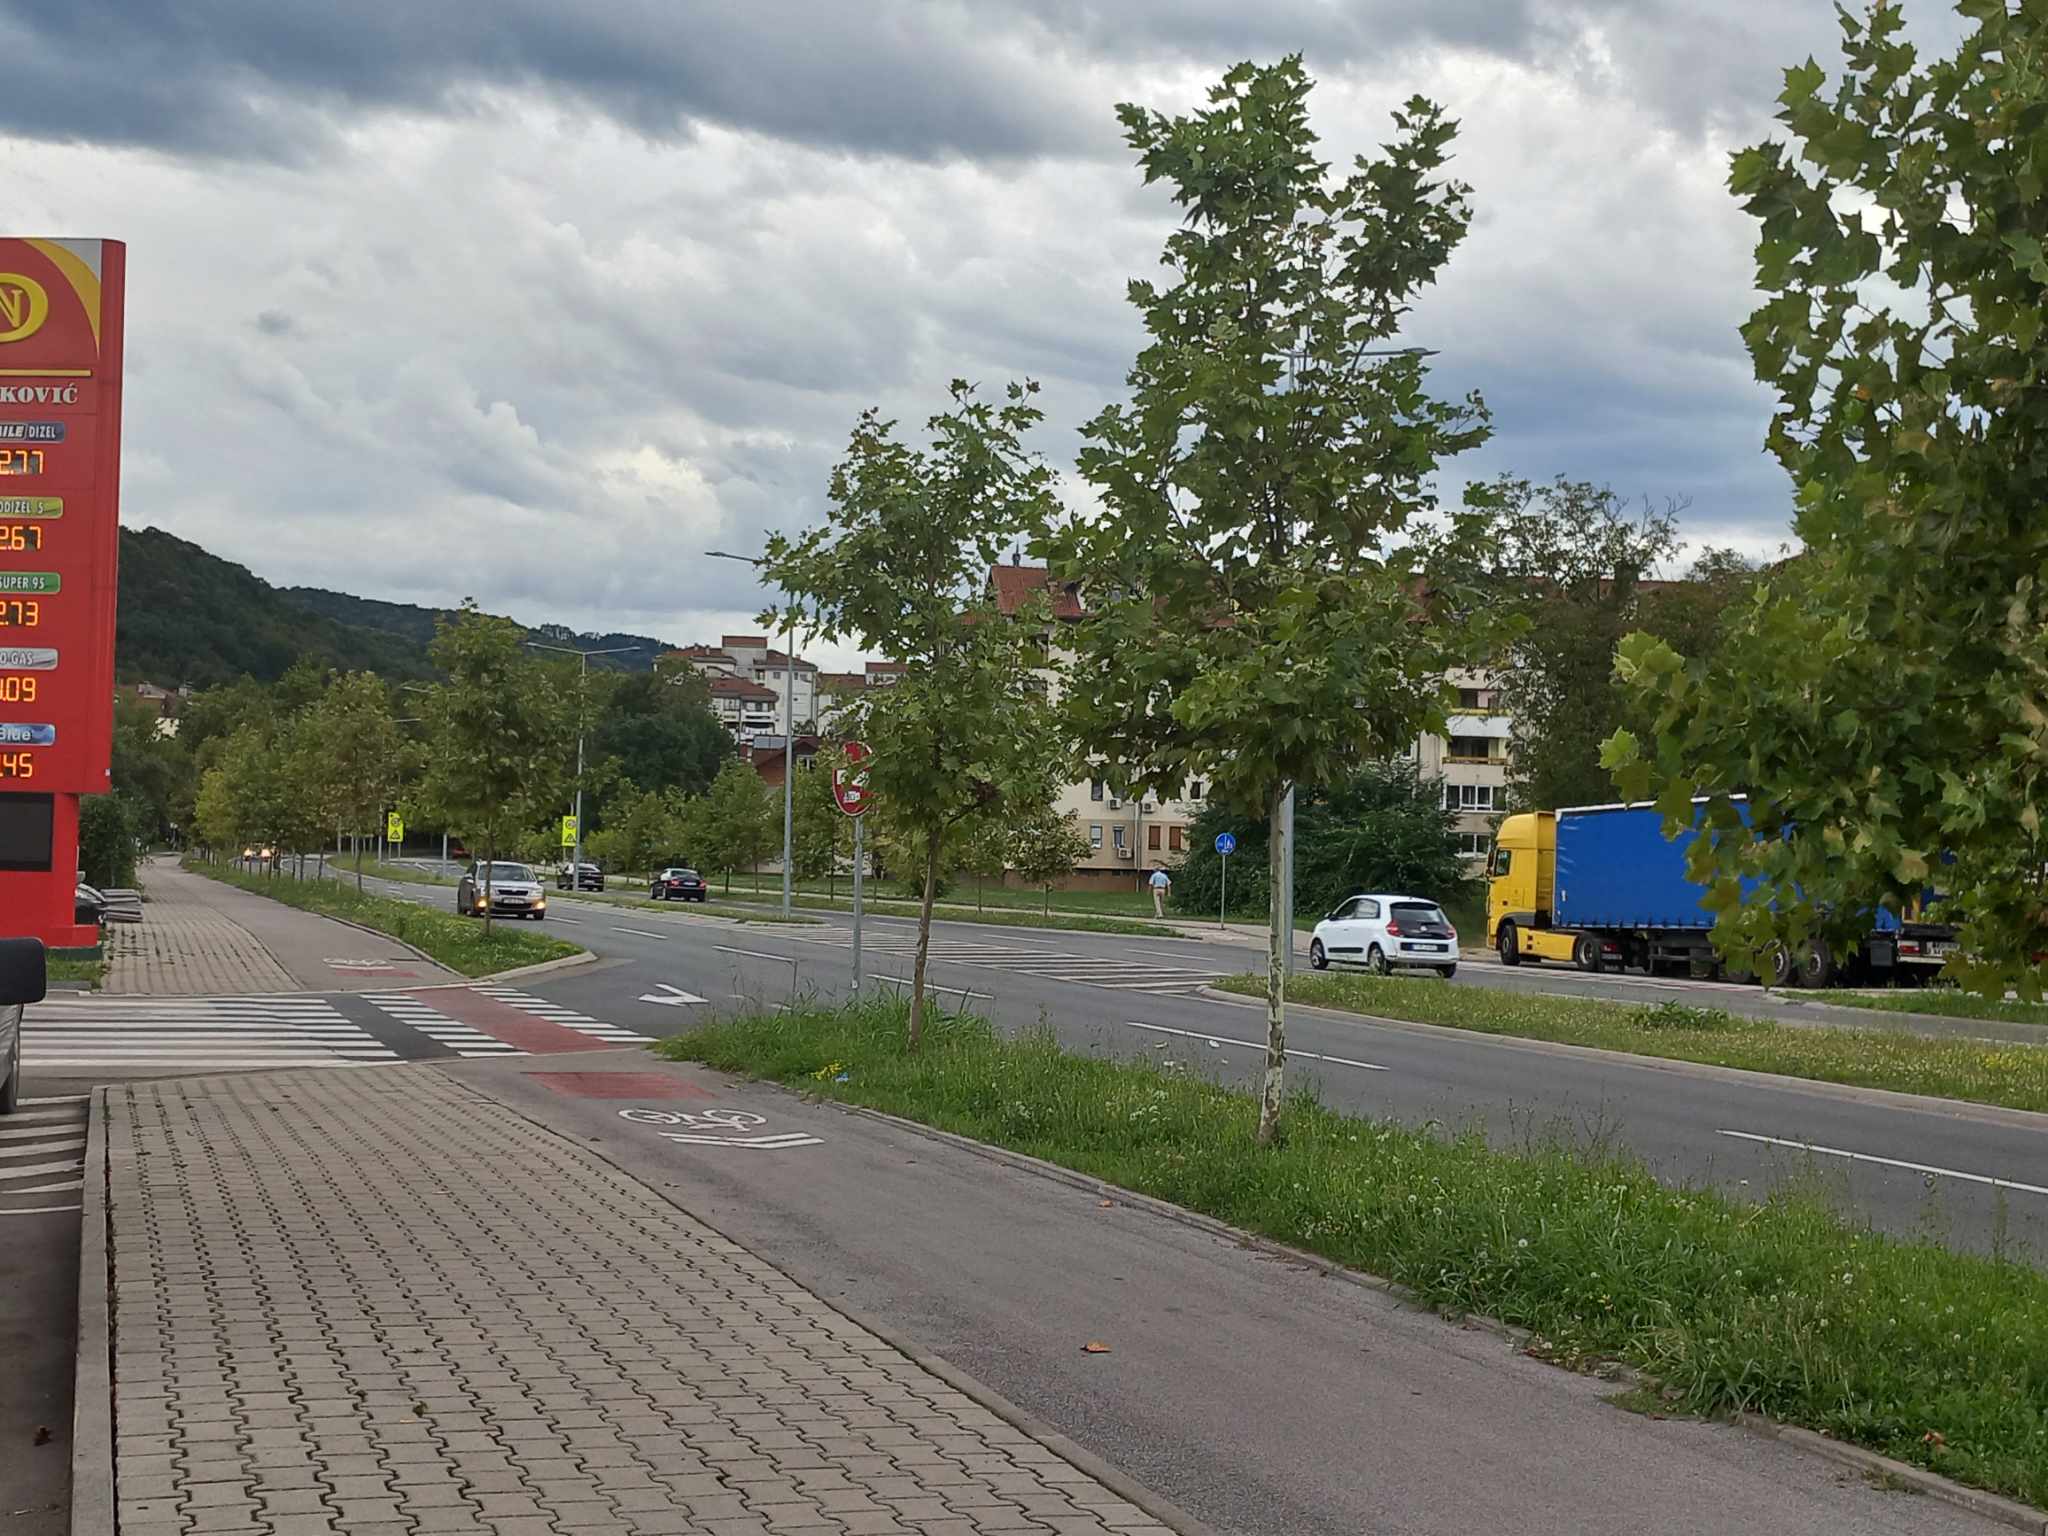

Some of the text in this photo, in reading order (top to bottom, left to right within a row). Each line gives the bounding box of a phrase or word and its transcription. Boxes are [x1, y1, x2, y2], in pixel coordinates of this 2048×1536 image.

[28, 426, 56, 439] DIZEL
[32, 576, 45, 590] 95
[11, 652, 33, 665] GAS
